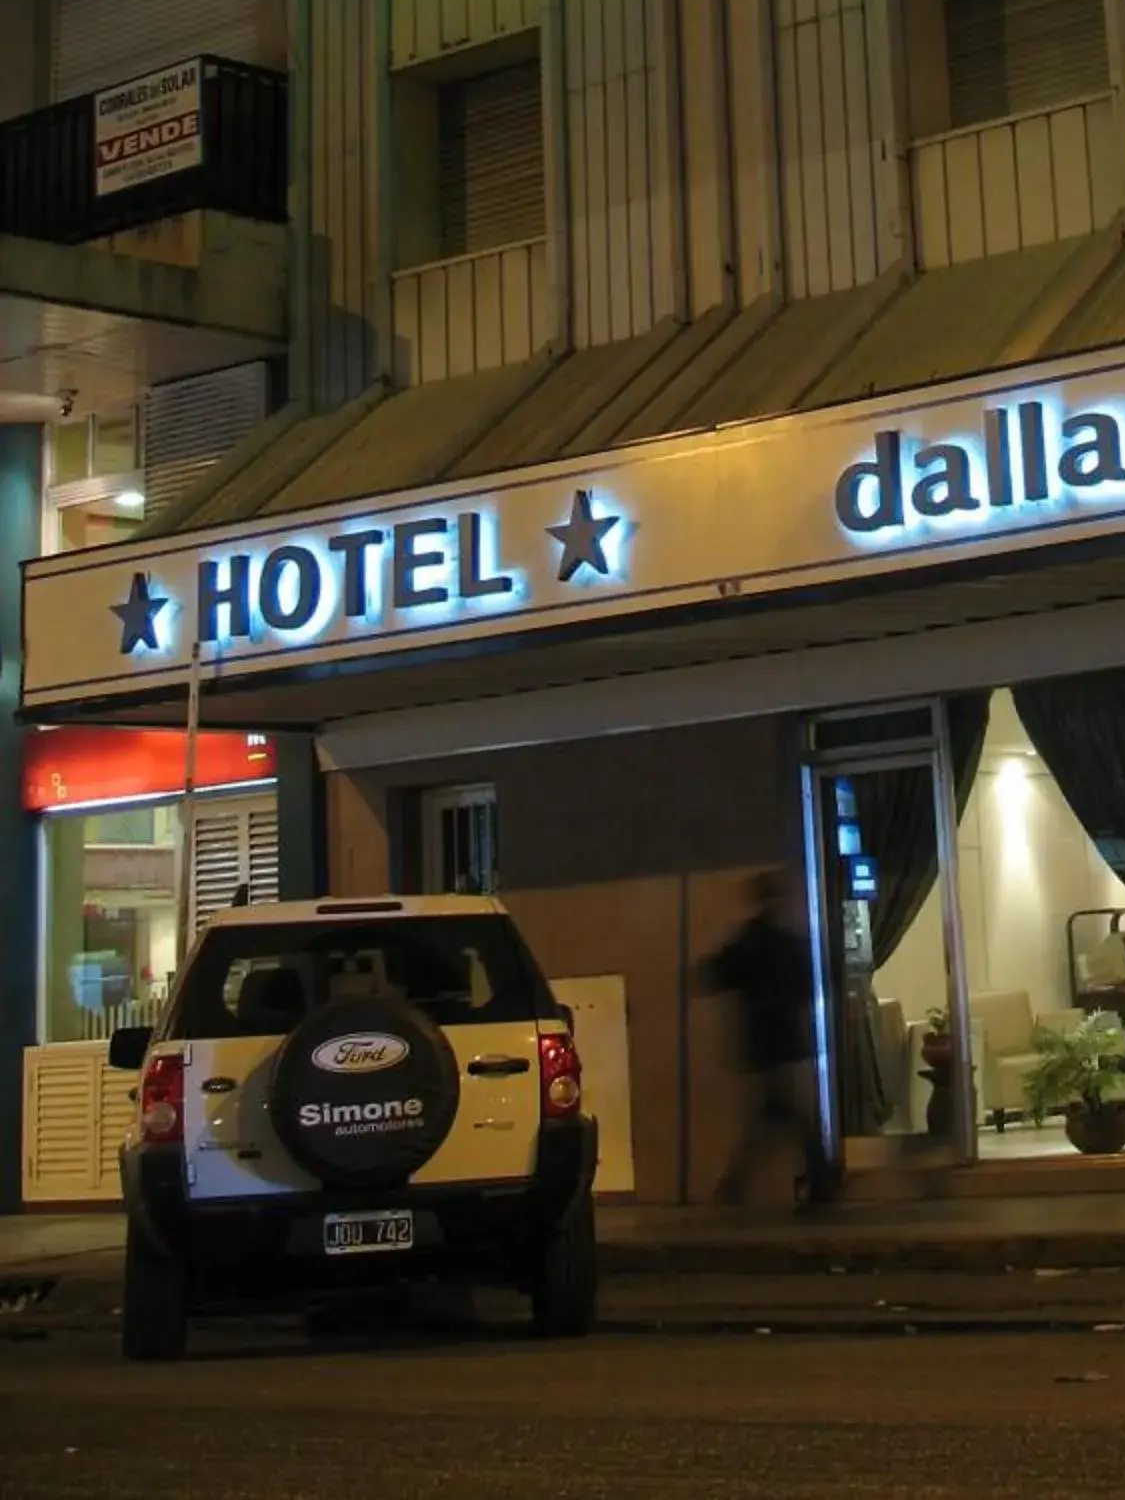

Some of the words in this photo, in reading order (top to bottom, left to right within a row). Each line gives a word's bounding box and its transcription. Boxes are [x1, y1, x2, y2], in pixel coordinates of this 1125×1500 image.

[101, 114, 197, 160] VENDE
[198, 512, 512, 642] HOTEL
[334, 1041, 386, 1065] Ford
[299, 1097, 424, 1127] Simone
[376, 1218, 409, 1243] 742
